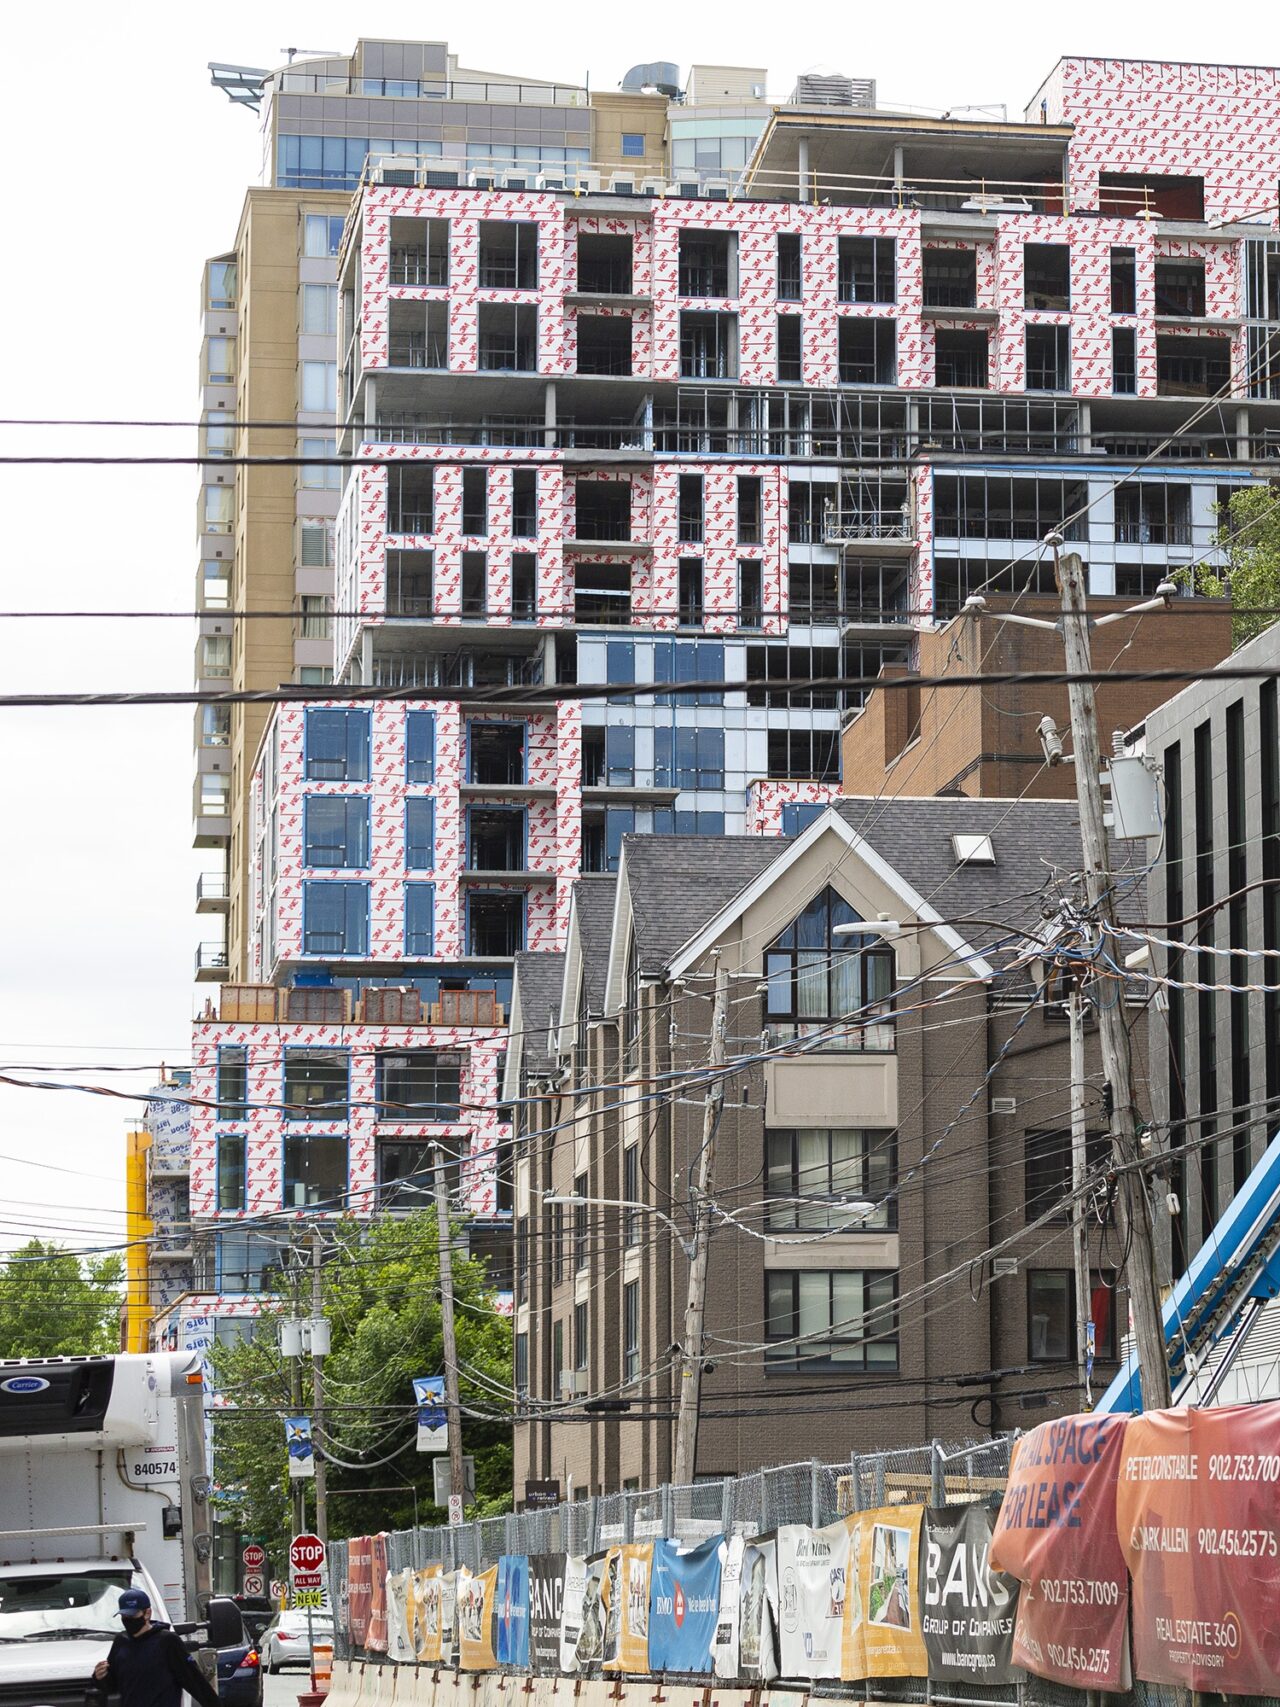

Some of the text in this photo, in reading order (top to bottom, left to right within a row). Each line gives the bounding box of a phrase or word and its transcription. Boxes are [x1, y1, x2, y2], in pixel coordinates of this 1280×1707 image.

[12, 1381, 38, 1389] Carrier
[1044, 1415, 1106, 1465] SPACE
[134, 1462, 176, 1476] 840574
[1026, 1481, 1083, 1529] LEASE
[292, 1545, 322, 1561] STOP
[1161, 1528, 1189, 1552] ALLEN
[1198, 1528, 1277, 1557] 902.456.2575
[245, 1552, 263, 1560] STOP
[297, 1594, 319, 1604] NEW
[1040, 1579, 1119, 1605] 902.753.7009
[656, 1596, 673, 1615] BMO
[1156, 1617, 1237, 1648] REAL ESTATE 360
[1047, 1643, 1110, 1674] 902.456.2575
